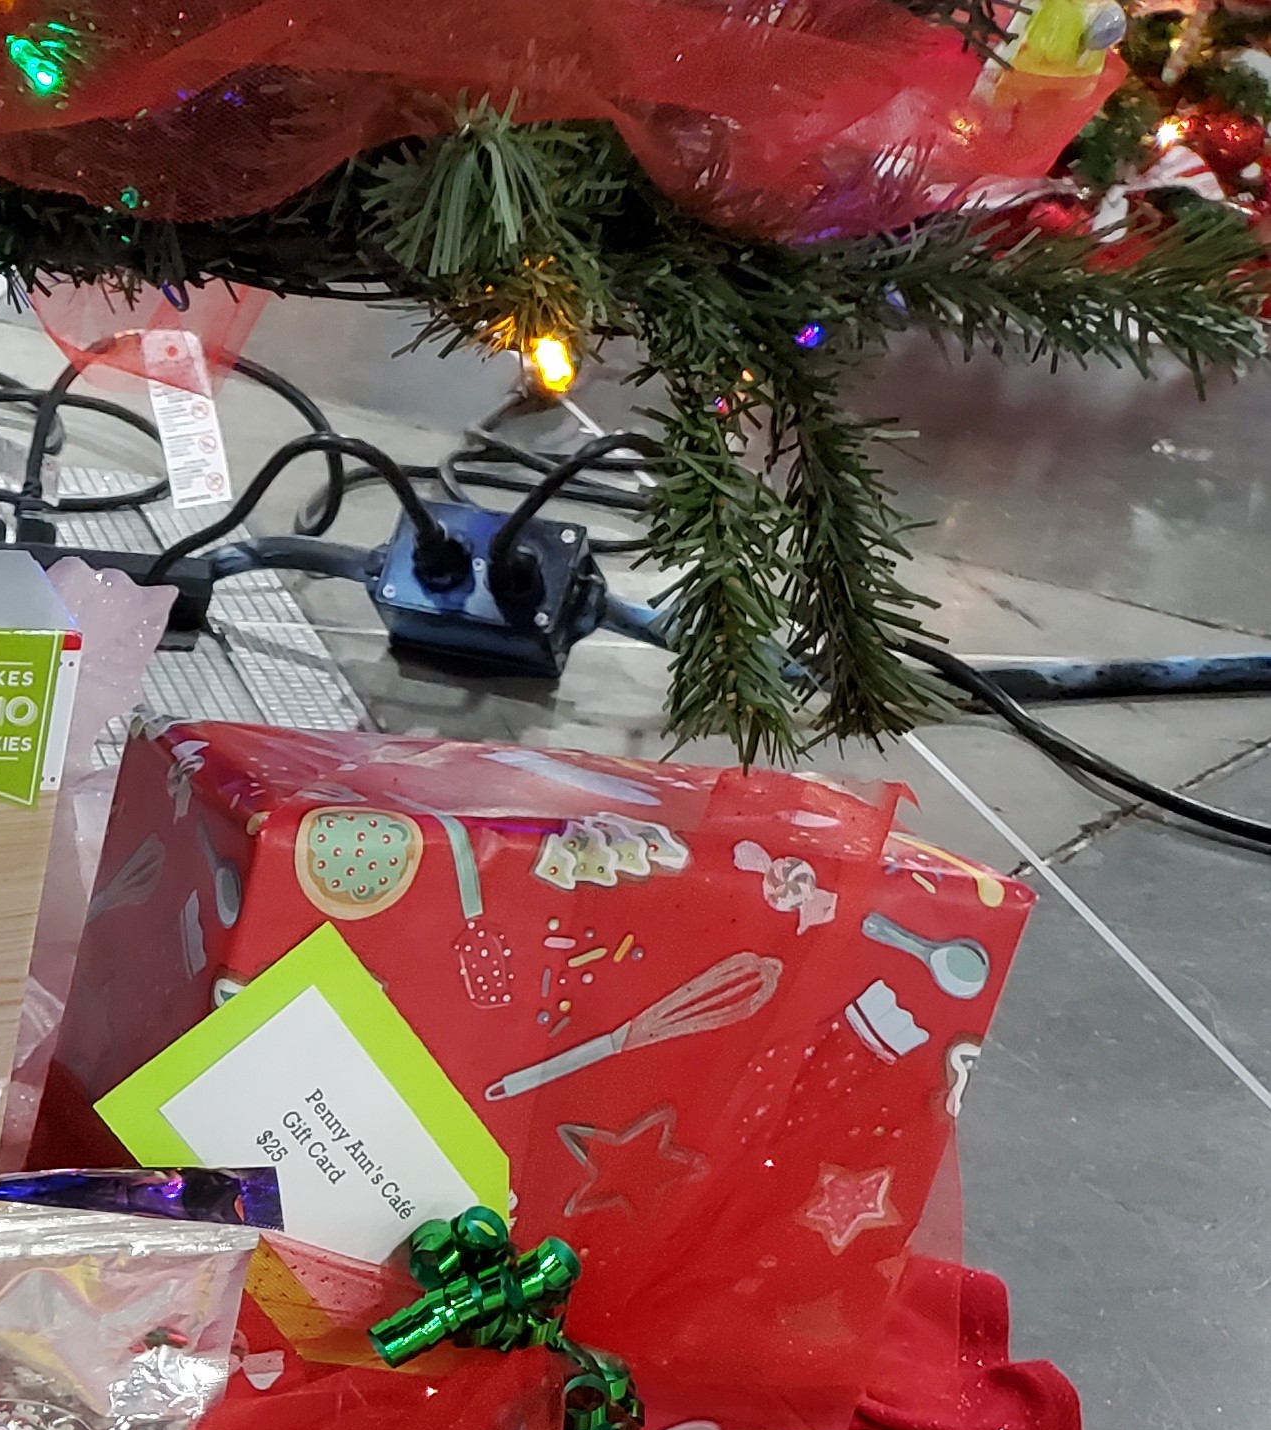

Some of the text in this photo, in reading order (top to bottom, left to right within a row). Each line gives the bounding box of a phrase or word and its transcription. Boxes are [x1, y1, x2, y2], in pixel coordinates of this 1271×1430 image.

[255, 1129, 289, 1163] $25
[281, 1110, 347, 1186] Gift Card
[304, 1087, 415, 1221] Penny Ann's Café
